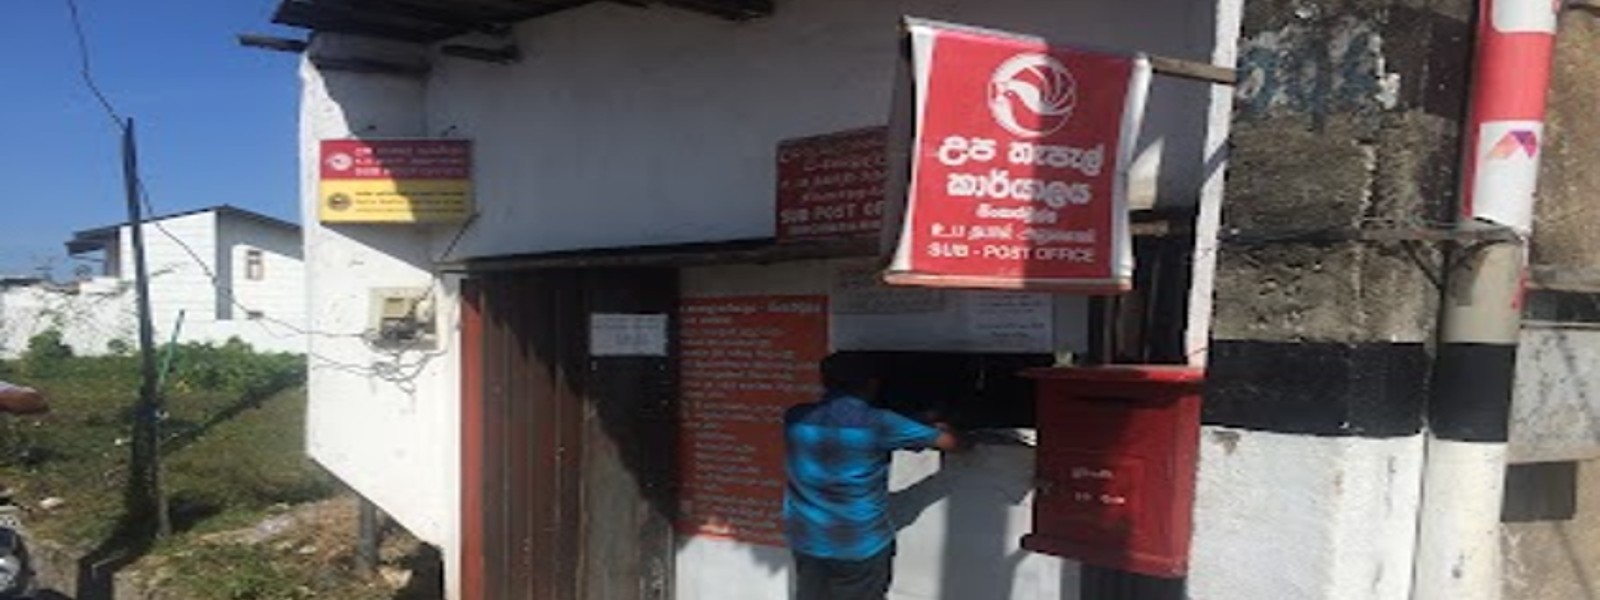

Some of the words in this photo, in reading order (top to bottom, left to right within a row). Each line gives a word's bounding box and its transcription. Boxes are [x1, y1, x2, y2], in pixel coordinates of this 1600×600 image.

[937, 135, 997, 166] උප
[947, 169, 1090, 207] කාර්යාලය
[928, 243, 969, 258] SUB
[983, 245, 1031, 260] POST
[1036, 247, 1095, 263] OFFICE
